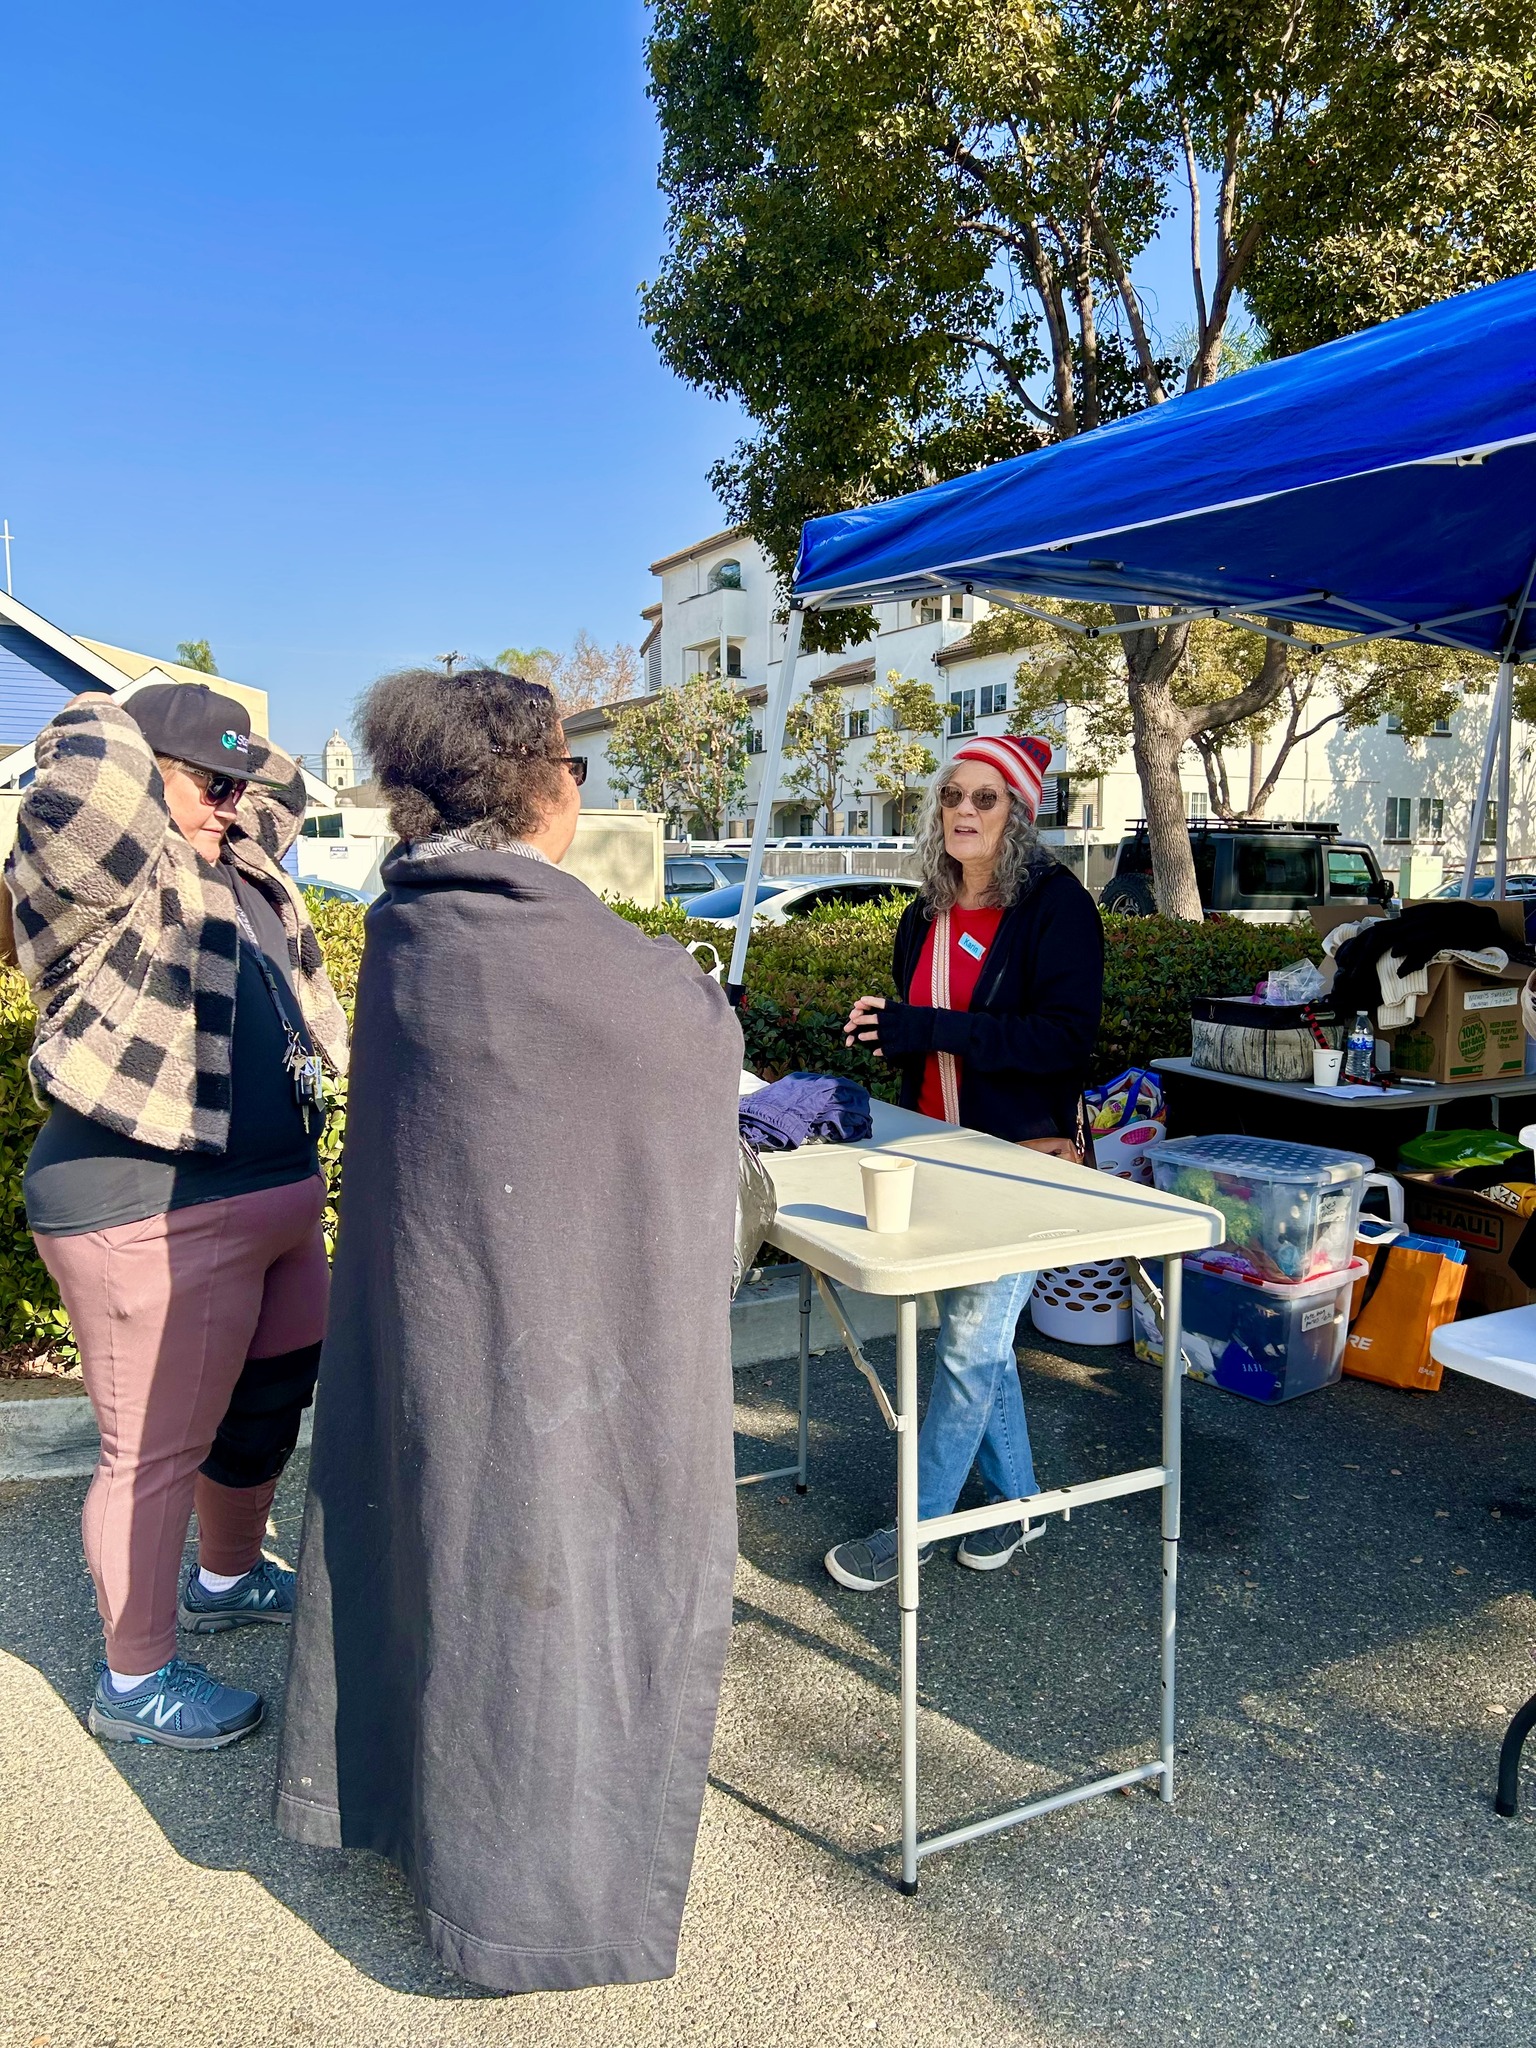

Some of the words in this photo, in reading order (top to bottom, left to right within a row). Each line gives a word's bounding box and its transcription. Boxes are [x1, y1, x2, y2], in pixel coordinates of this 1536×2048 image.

[963, 937, 979, 954] Karin
[1461, 1023, 1483, 1040] 100%
[1413, 1201, 1497, 1238] U-HAUL
